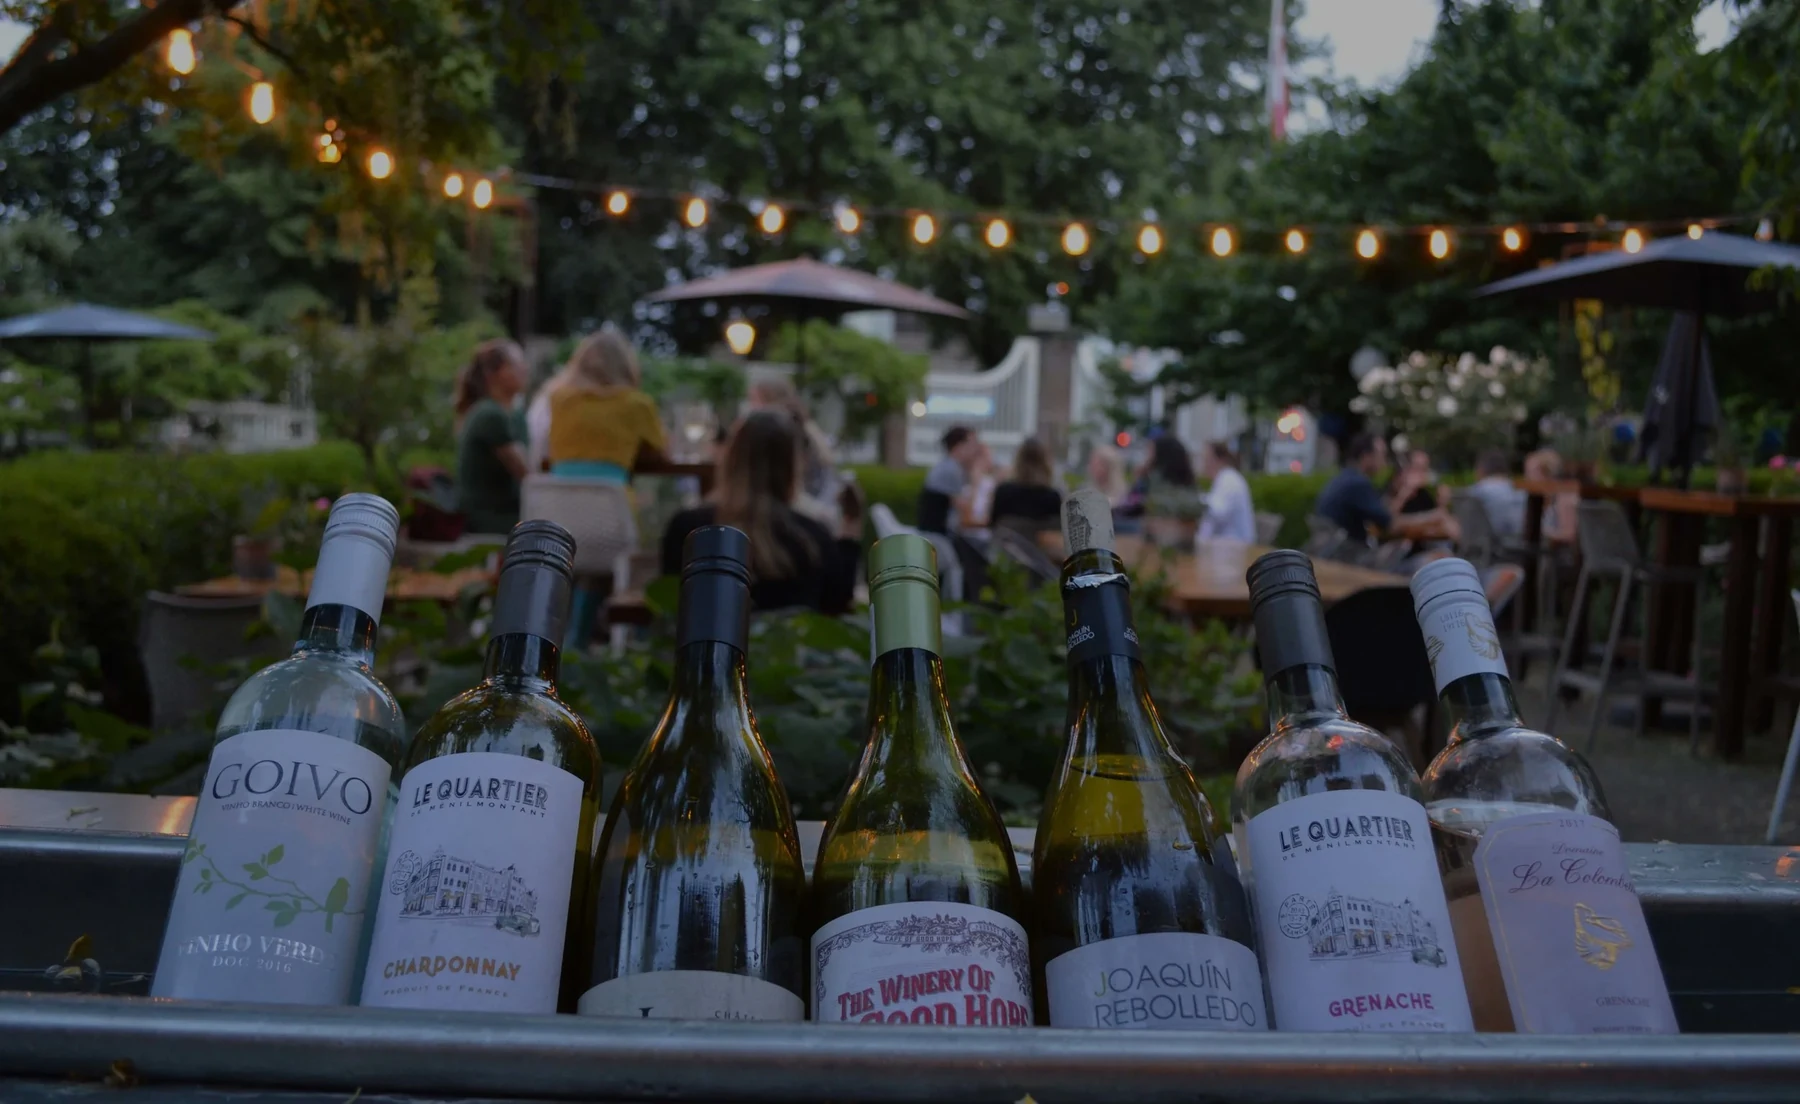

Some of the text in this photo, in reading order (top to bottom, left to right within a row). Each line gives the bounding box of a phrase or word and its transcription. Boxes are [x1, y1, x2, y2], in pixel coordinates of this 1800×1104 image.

[212, 759, 372, 815] GOIVO
[412, 777, 548, 810] LE QUARTIER
[221, 800, 352, 825] VINHO BRANCO WHITE WINE
[1279, 815, 1415, 852] LE QUARTIER
[1282, 853, 1296, 861] DE
[1508, 860, 1555, 893] La
[256, 958, 292, 973] 2016
[260, 935, 332, 968] VERD
[383, 956, 521, 981] CHARDONNAY
[1094, 959, 1232, 997] JOAQUÍN
[838, 964, 996, 1021] THE WINERY OF
[1329, 993, 1435, 1017] GRENACHE
[1095, 994, 1257, 1029] REBOLLEDO
